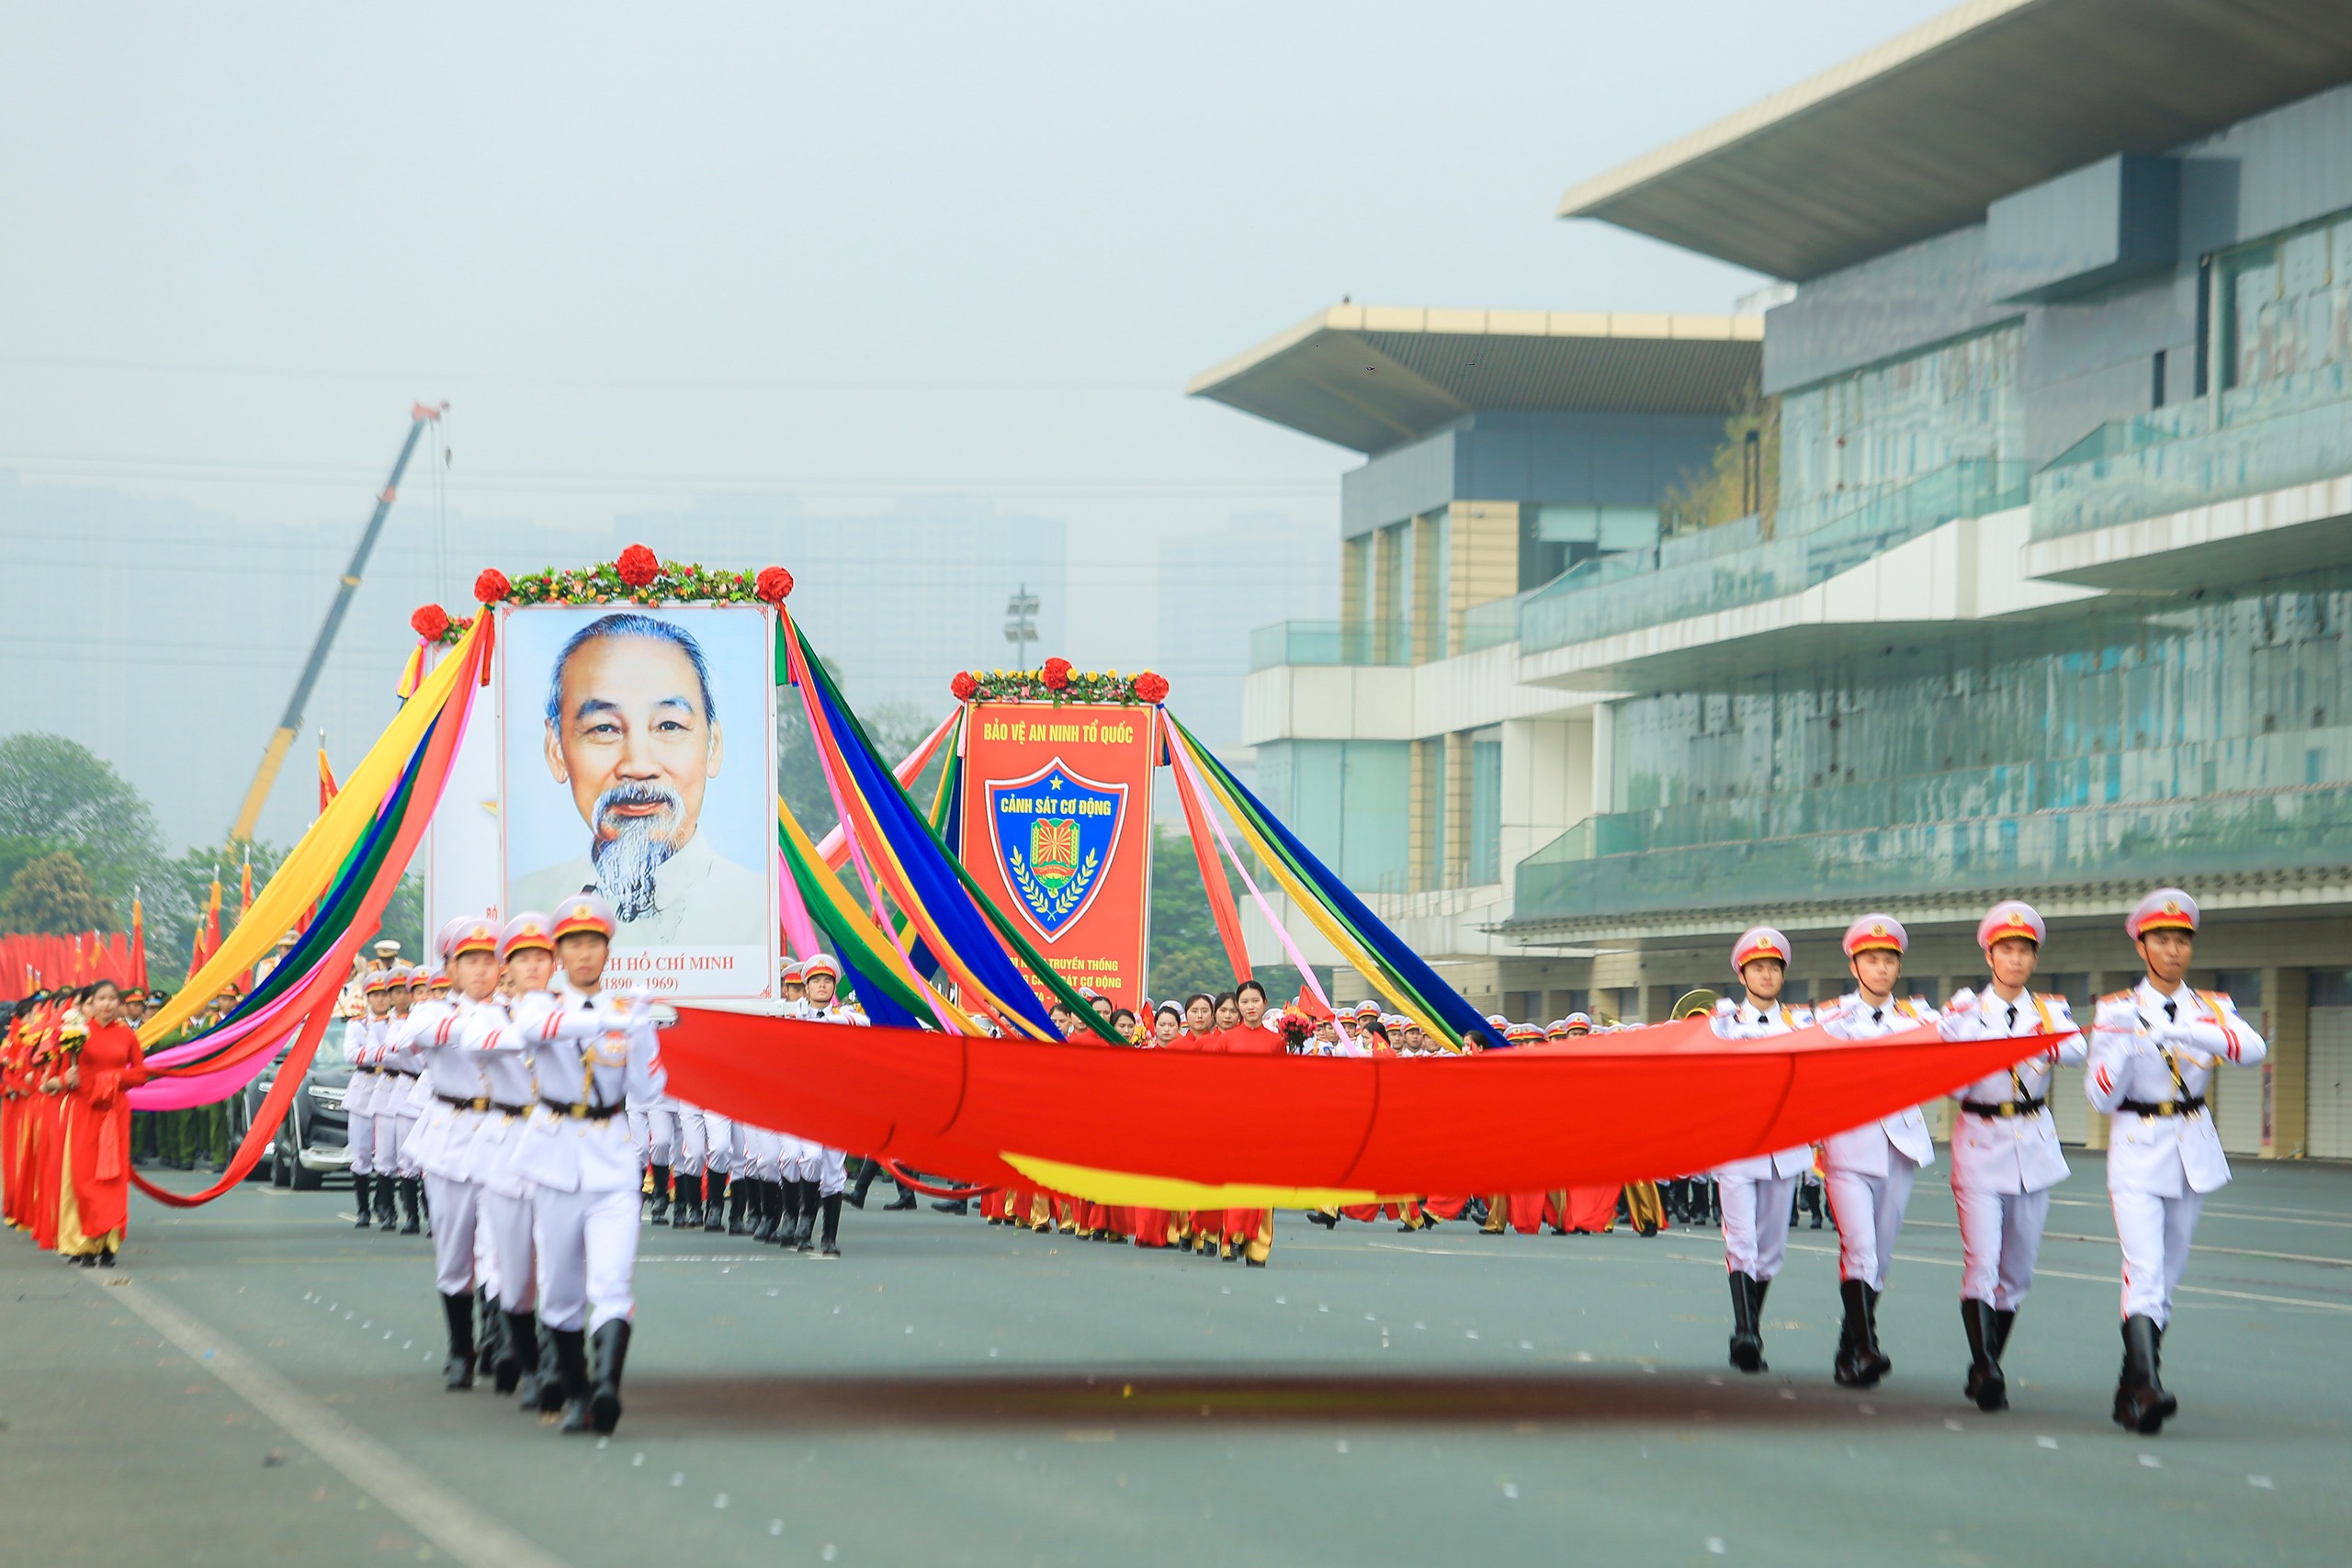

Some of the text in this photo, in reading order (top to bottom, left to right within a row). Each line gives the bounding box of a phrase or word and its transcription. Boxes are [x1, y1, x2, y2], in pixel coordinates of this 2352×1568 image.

[983, 717, 1134, 745] BẢO VỆ AN NINH TỔ QUỐC
[1001, 794, 1111, 818] CẢNH SÁT CƠ ĐỘNG
[627, 951, 651, 971] HỒ
[655, 953, 685, 971] CHÍ
[689, 956, 735, 970] MINH
[1087, 956, 1119, 972] THỐNG
[646, 976, 680, 992] 1969)
[1080, 976, 1093, 987] CƠ
[1095, 975, 1122, 990] ĐỘNG
